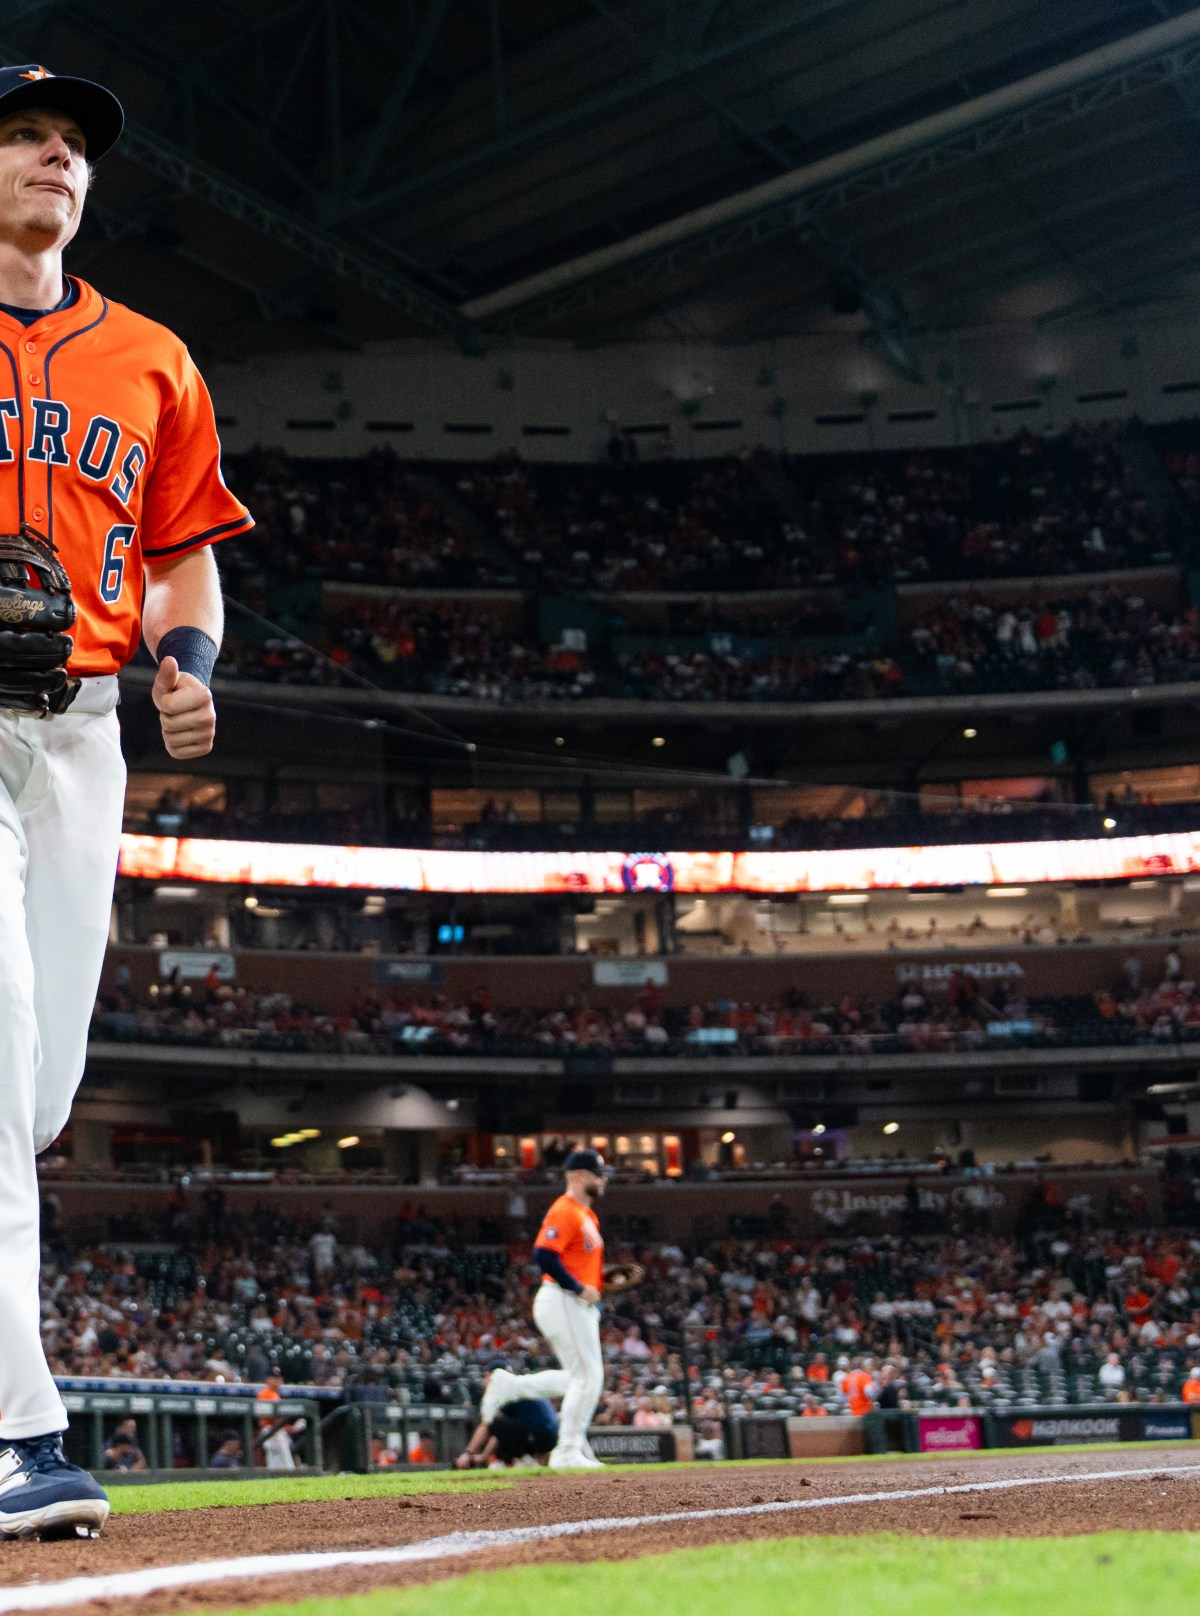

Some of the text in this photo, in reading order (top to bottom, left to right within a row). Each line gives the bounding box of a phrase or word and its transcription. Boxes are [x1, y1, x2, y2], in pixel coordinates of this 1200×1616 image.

[98, 523, 138, 604] 6
[842, 1190, 947, 1216] Inspeity
[925, 1426, 971, 1445] reliant
